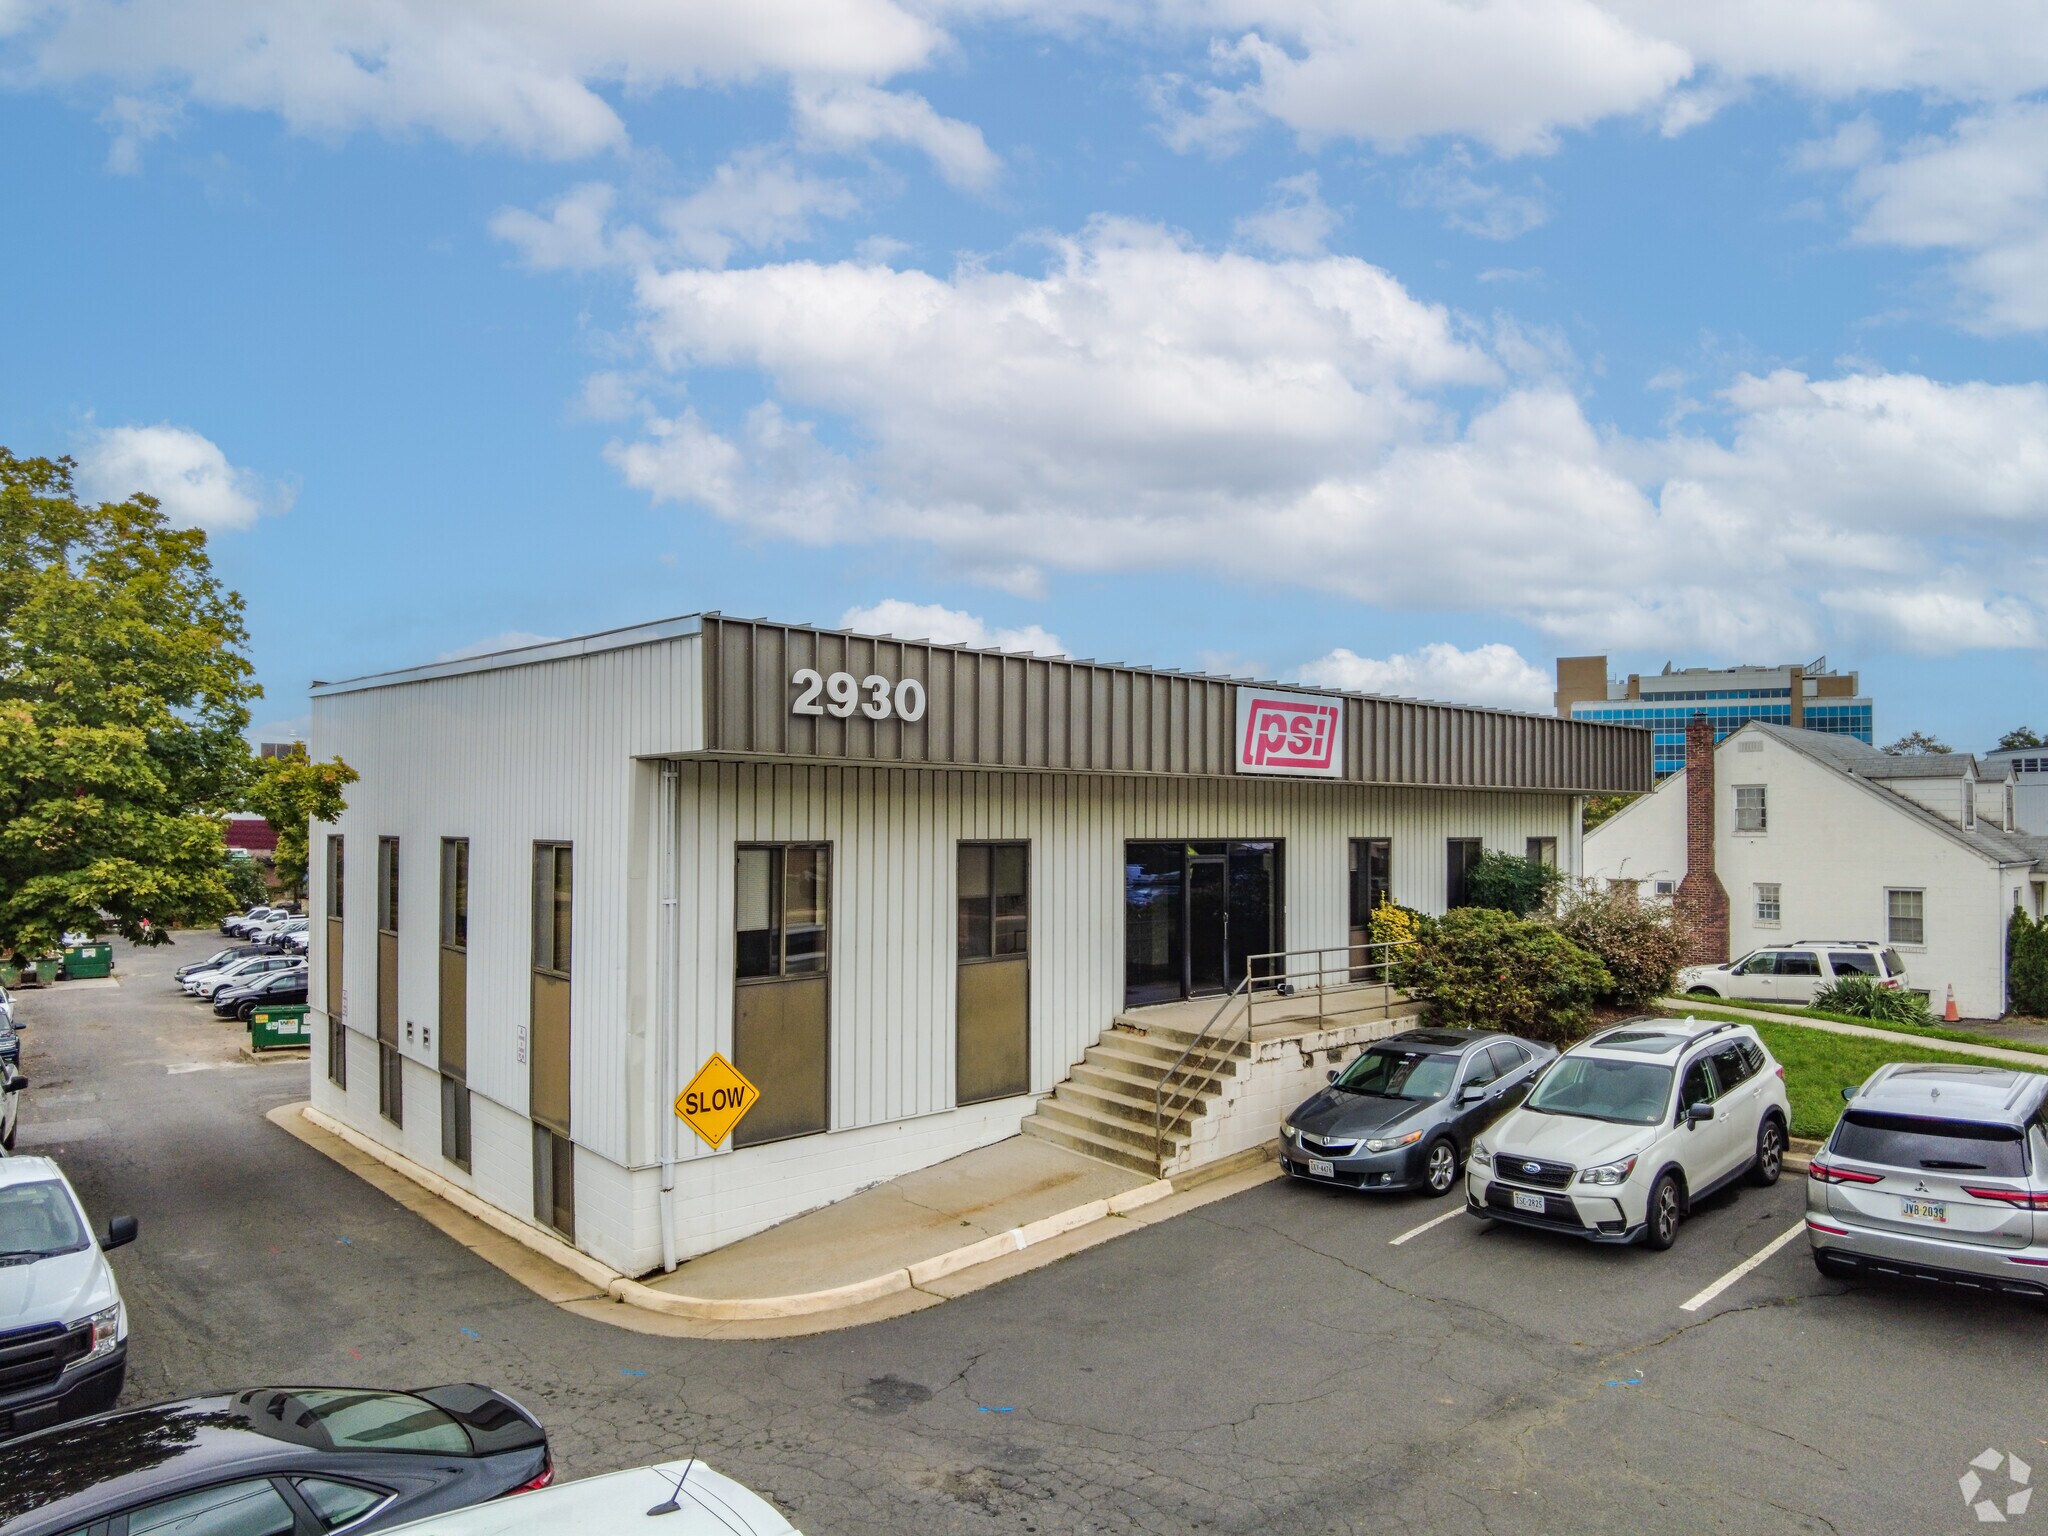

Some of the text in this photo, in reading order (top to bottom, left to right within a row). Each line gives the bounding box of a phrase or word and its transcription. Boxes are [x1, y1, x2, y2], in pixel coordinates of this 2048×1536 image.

[792, 668, 926, 722] 2930
[1254, 706, 1328, 766] psi
[685, 1086, 745, 1115] SLOW
[1903, 1203, 1944, 1218] JVB 2039
